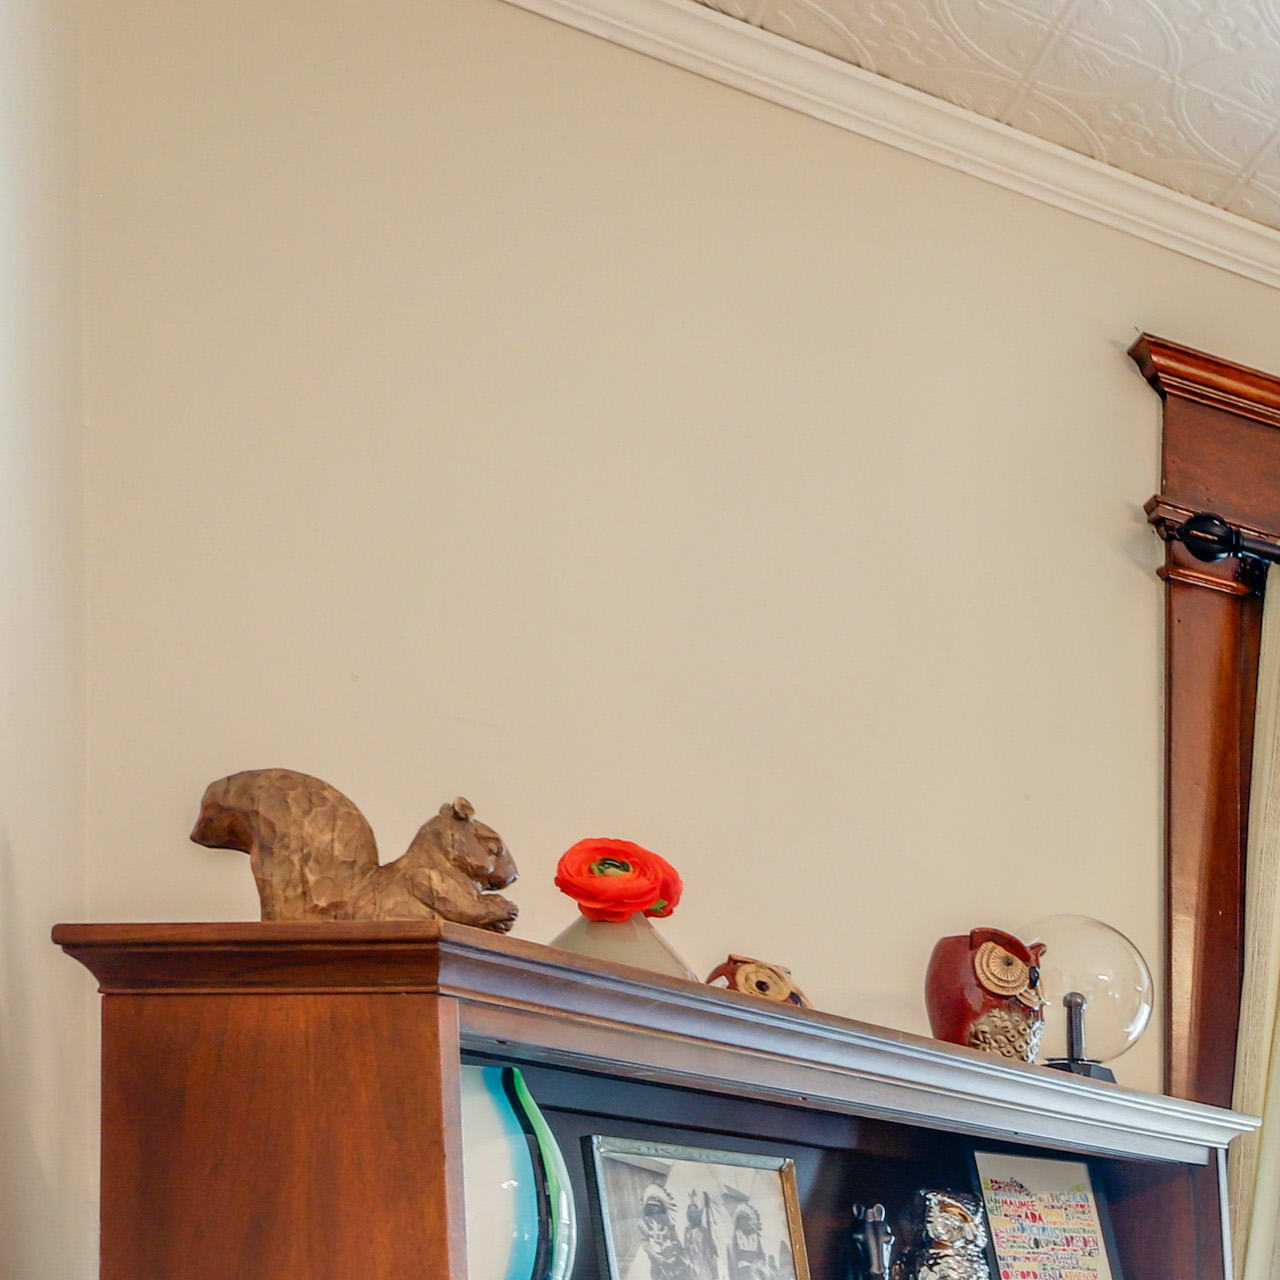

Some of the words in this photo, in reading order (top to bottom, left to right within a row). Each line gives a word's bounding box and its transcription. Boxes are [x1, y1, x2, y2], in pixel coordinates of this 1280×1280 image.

[1001, 1198, 1038, 1213] MAUMEE
[1024, 1210, 1044, 1224] ADA
[1065, 1235, 1099, 1249] DRESDEN
[1002, 1270, 1038, 1280] OXFORD
[1039, 1268, 1064, 1280] XENIA
